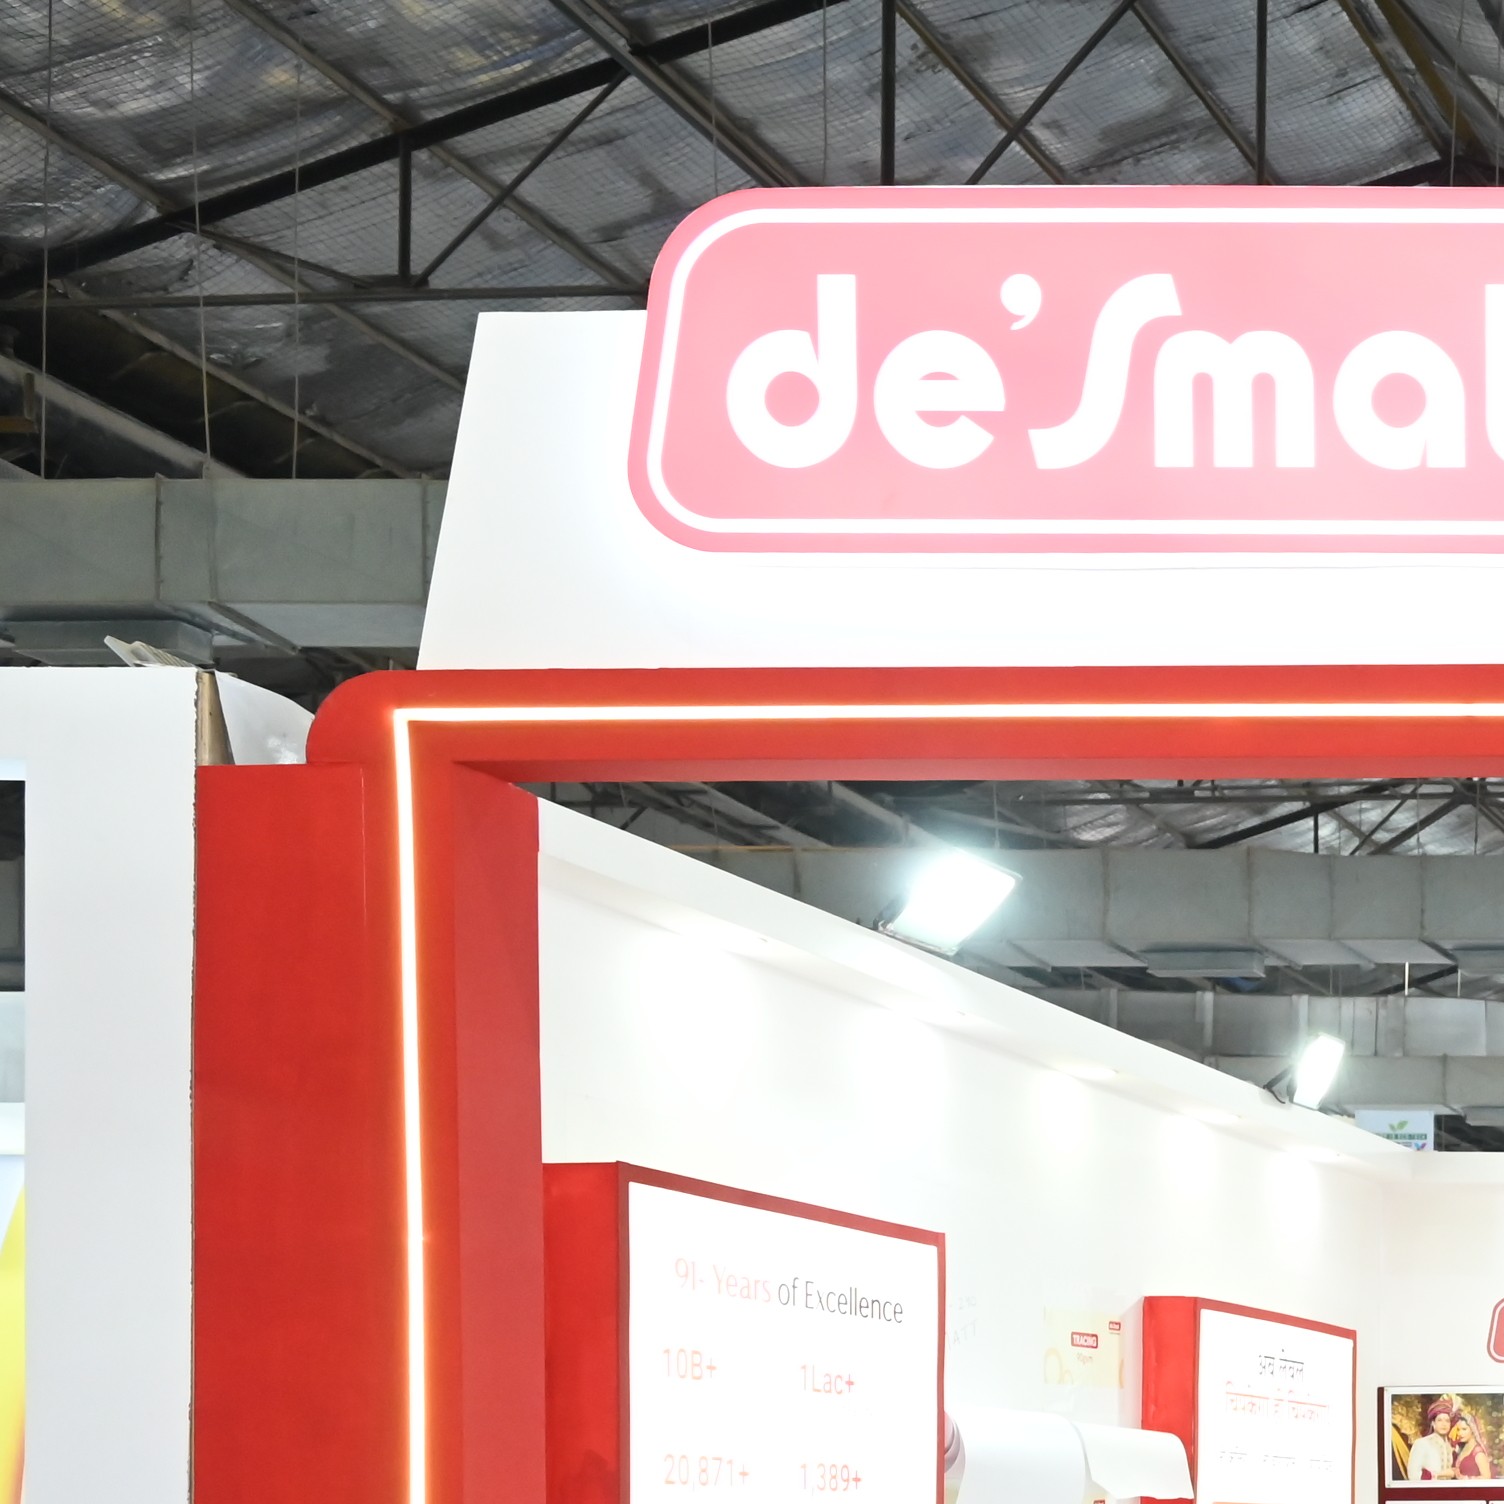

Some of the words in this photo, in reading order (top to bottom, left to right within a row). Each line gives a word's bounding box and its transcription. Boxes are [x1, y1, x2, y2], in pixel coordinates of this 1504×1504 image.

[712, 1263, 773, 1304] Years
[777, 1276, 801, 1307] of
[804, 1280, 905, 1325] Excellence
[662, 1348, 718, 1381] 10B+
[799, 1363, 856, 1396] 1Lac+
[662, 1453, 750, 1493] 20,871+
[799, 1463, 863, 1497] 1,389+
